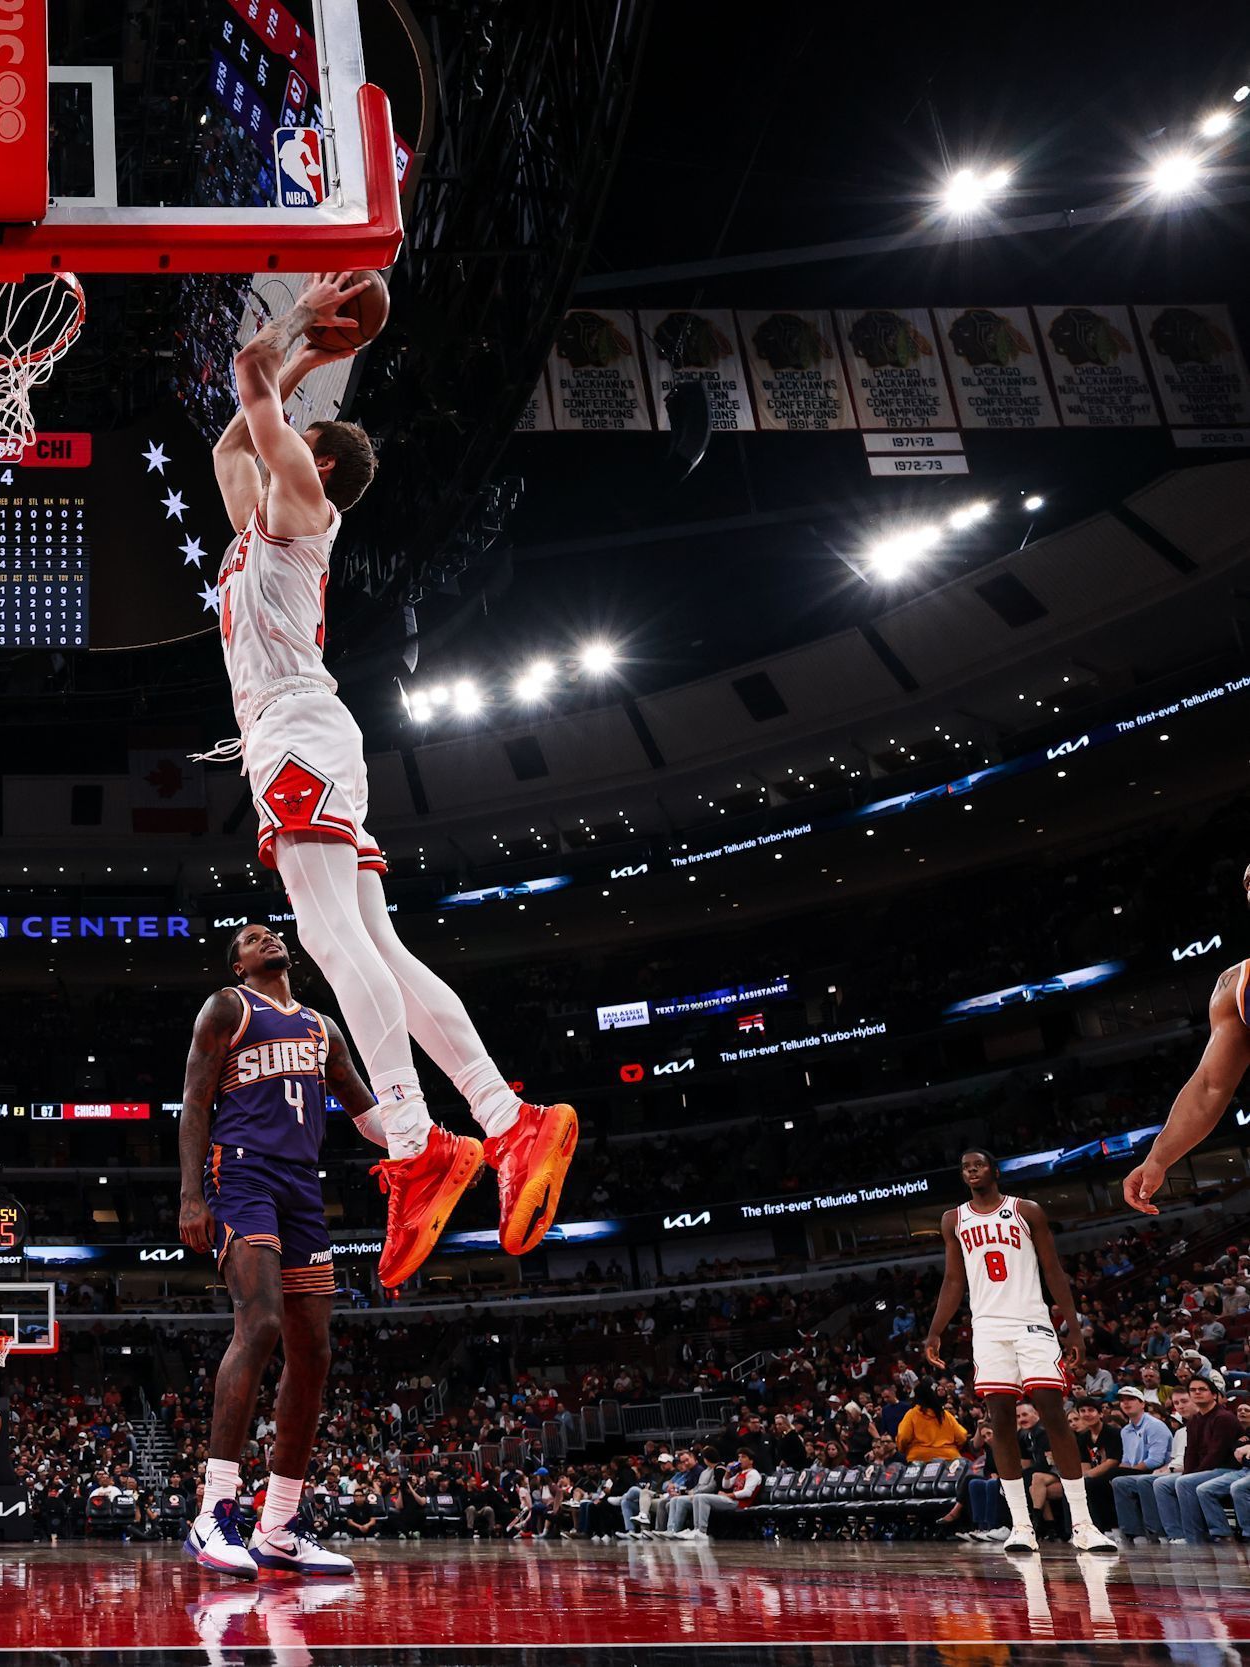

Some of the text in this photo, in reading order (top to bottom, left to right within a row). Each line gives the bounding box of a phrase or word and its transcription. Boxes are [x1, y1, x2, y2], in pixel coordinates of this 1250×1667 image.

[223, 21, 233, 43] FG
[240, 39, 249, 61] FT
[258, 54, 269, 86] 3PT
[290, 78, 302, 103] 67
[286, 192, 308, 205] NBA
[572, 370, 620, 379] CHICAGO
[774, 371, 822, 380] CHICAGO
[560, 380, 635, 389] BLACKHAWKS
[571, 390, 627, 399] WESTERN
[867, 397, 941, 407] CONFERENCE
[563, 400, 638, 409] CONFERENCE
[570, 409, 633, 419] CHAMPIONS
[582, 420, 625, 429] 2012-13
[36, 440, 72, 459] CHI
[1116, 719, 1135, 732] The
[1136, 704, 1179, 725] first-ever
[1181, 688, 1224, 709] Telluride
[671, 824, 811, 867] The first-ever Telluride Turbo-Hybrid
[21, 917, 191, 937] CENTER
[268, 914, 282, 922] The
[655, 1007, 674, 1015] TEXT
[721, 995, 737, 1004] FOR
[739, 984, 788, 1000] ASSISTANCE
[619, 1008, 643, 1016] ASSIST
[720, 1023, 886, 1063] The first-ever Telluride Turbo-Hybrid
[41, 1104, 111, 1117] 67 CHICAGO
[283, 1079, 304, 1125] 4
[741, 1179, 928, 1218] The first-ever Telluride Turbo-Hybrid
[961, 1224, 1021, 1254] BULLS
[330, 1243, 382, 1255] rbo-Hybrid
[984, 1251, 1008, 1282] 8
